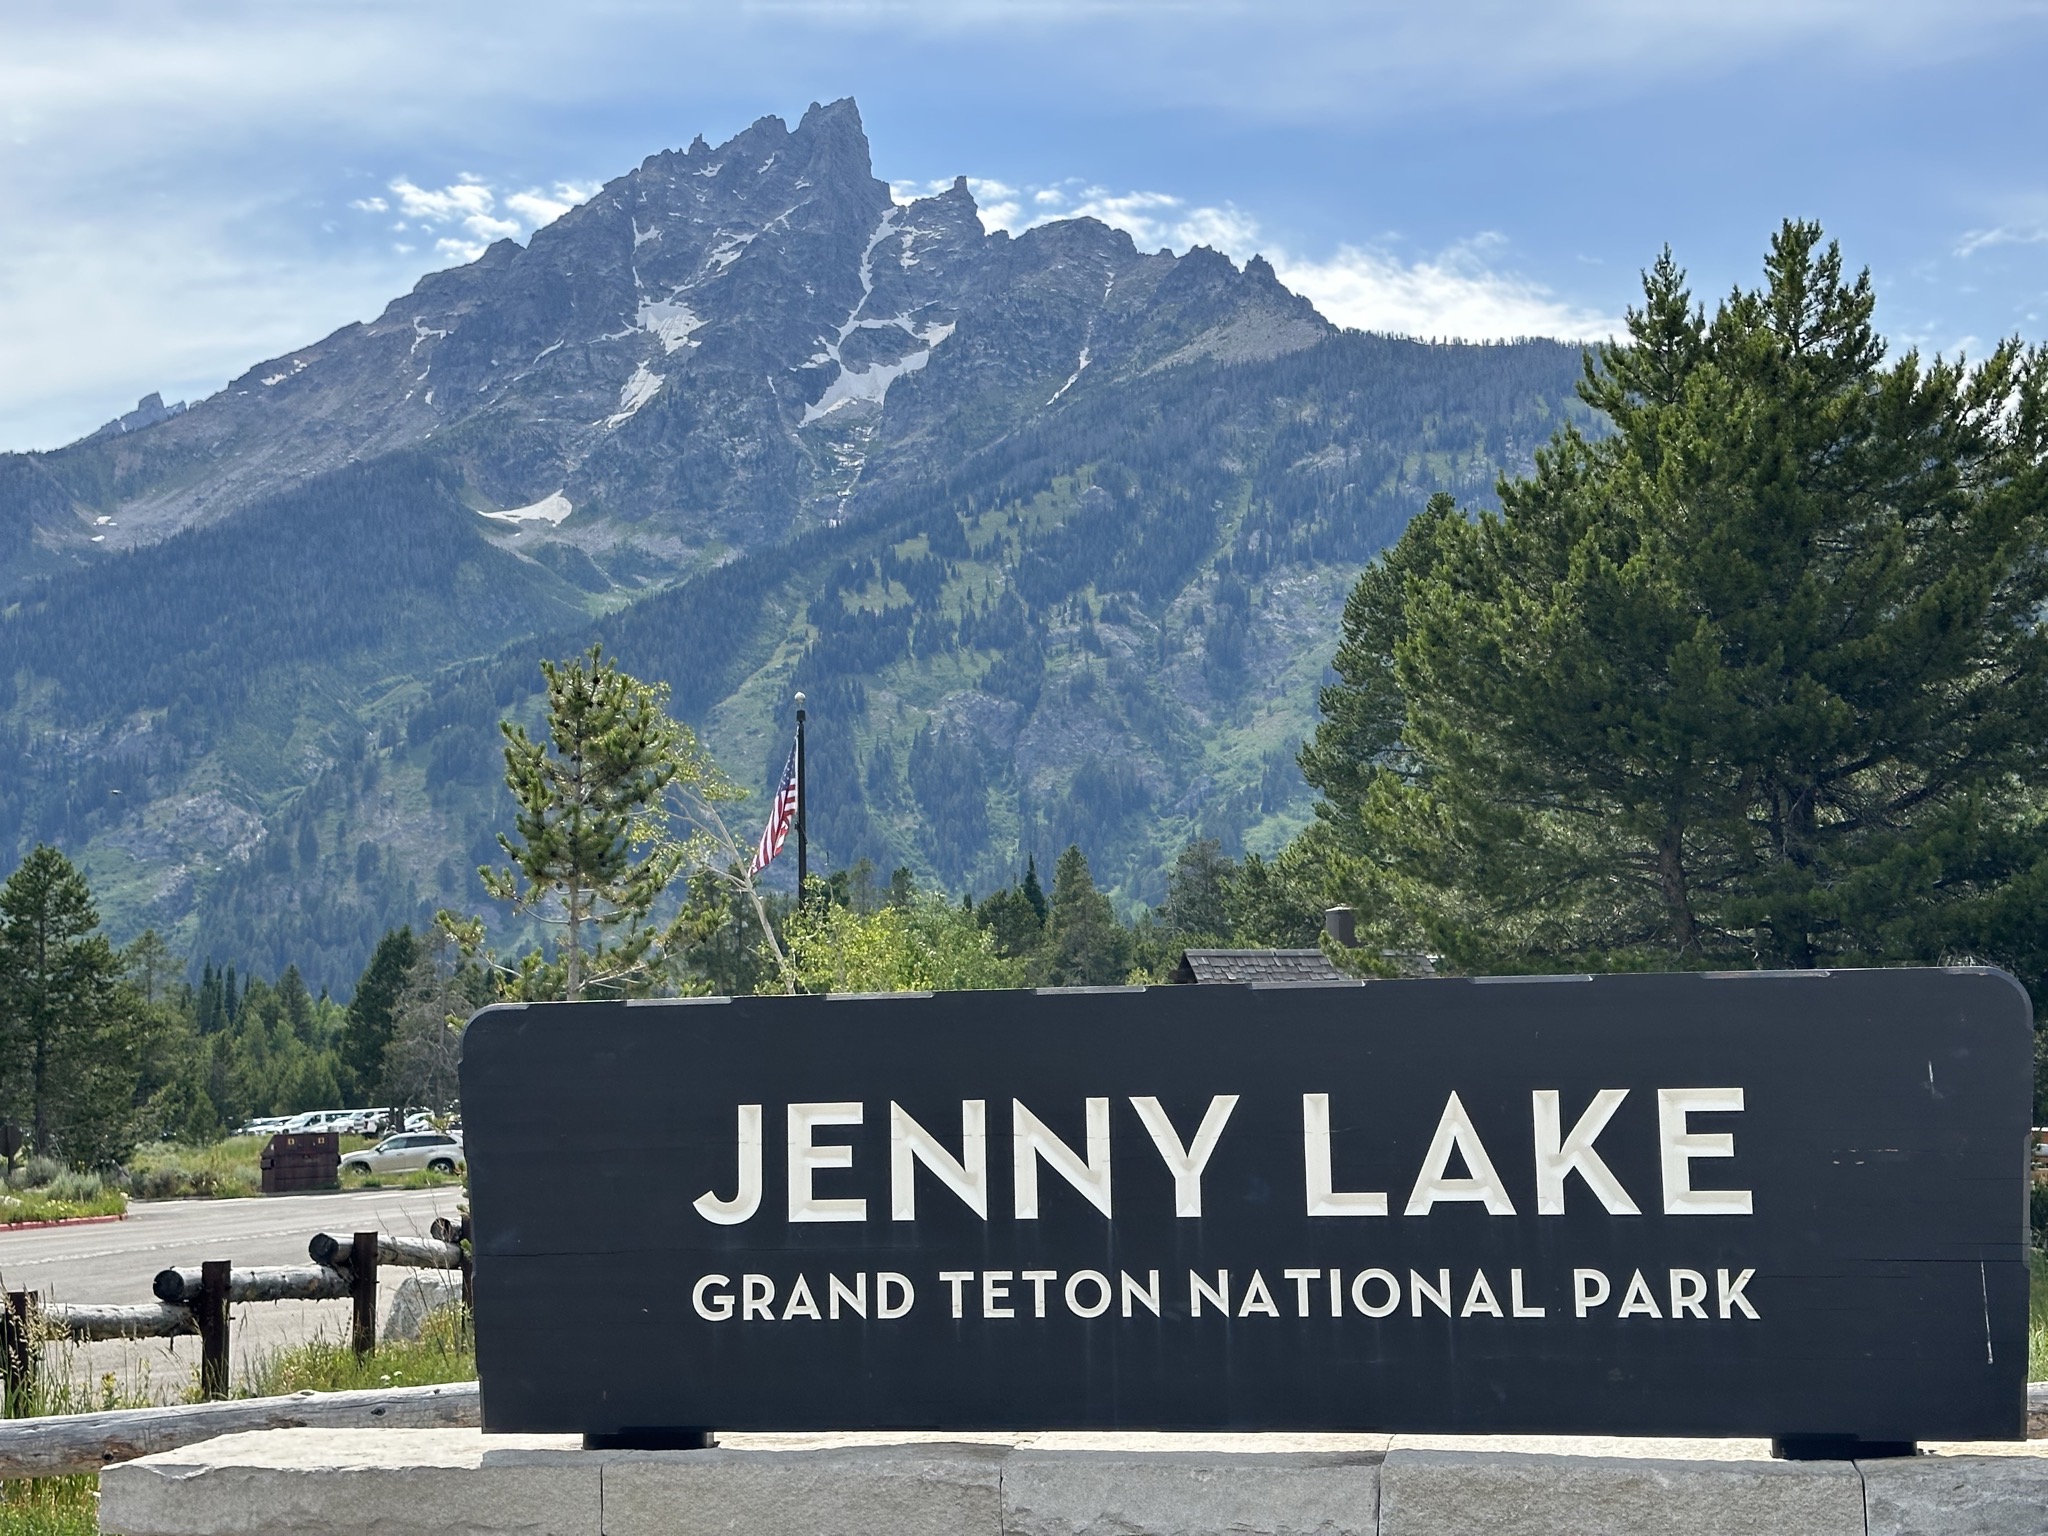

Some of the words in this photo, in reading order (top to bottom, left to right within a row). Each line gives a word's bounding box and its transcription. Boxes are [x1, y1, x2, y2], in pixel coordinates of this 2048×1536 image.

[692, 1094, 1241, 1226] JENNY
[1302, 1087, 1754, 1217] LAKE
[692, 1272, 915, 1322] GRAND
[938, 1269, 1161, 1319] TETON
[1189, 1267, 1546, 1318] NATIONAL
[1573, 1267, 1762, 1320] PARK
